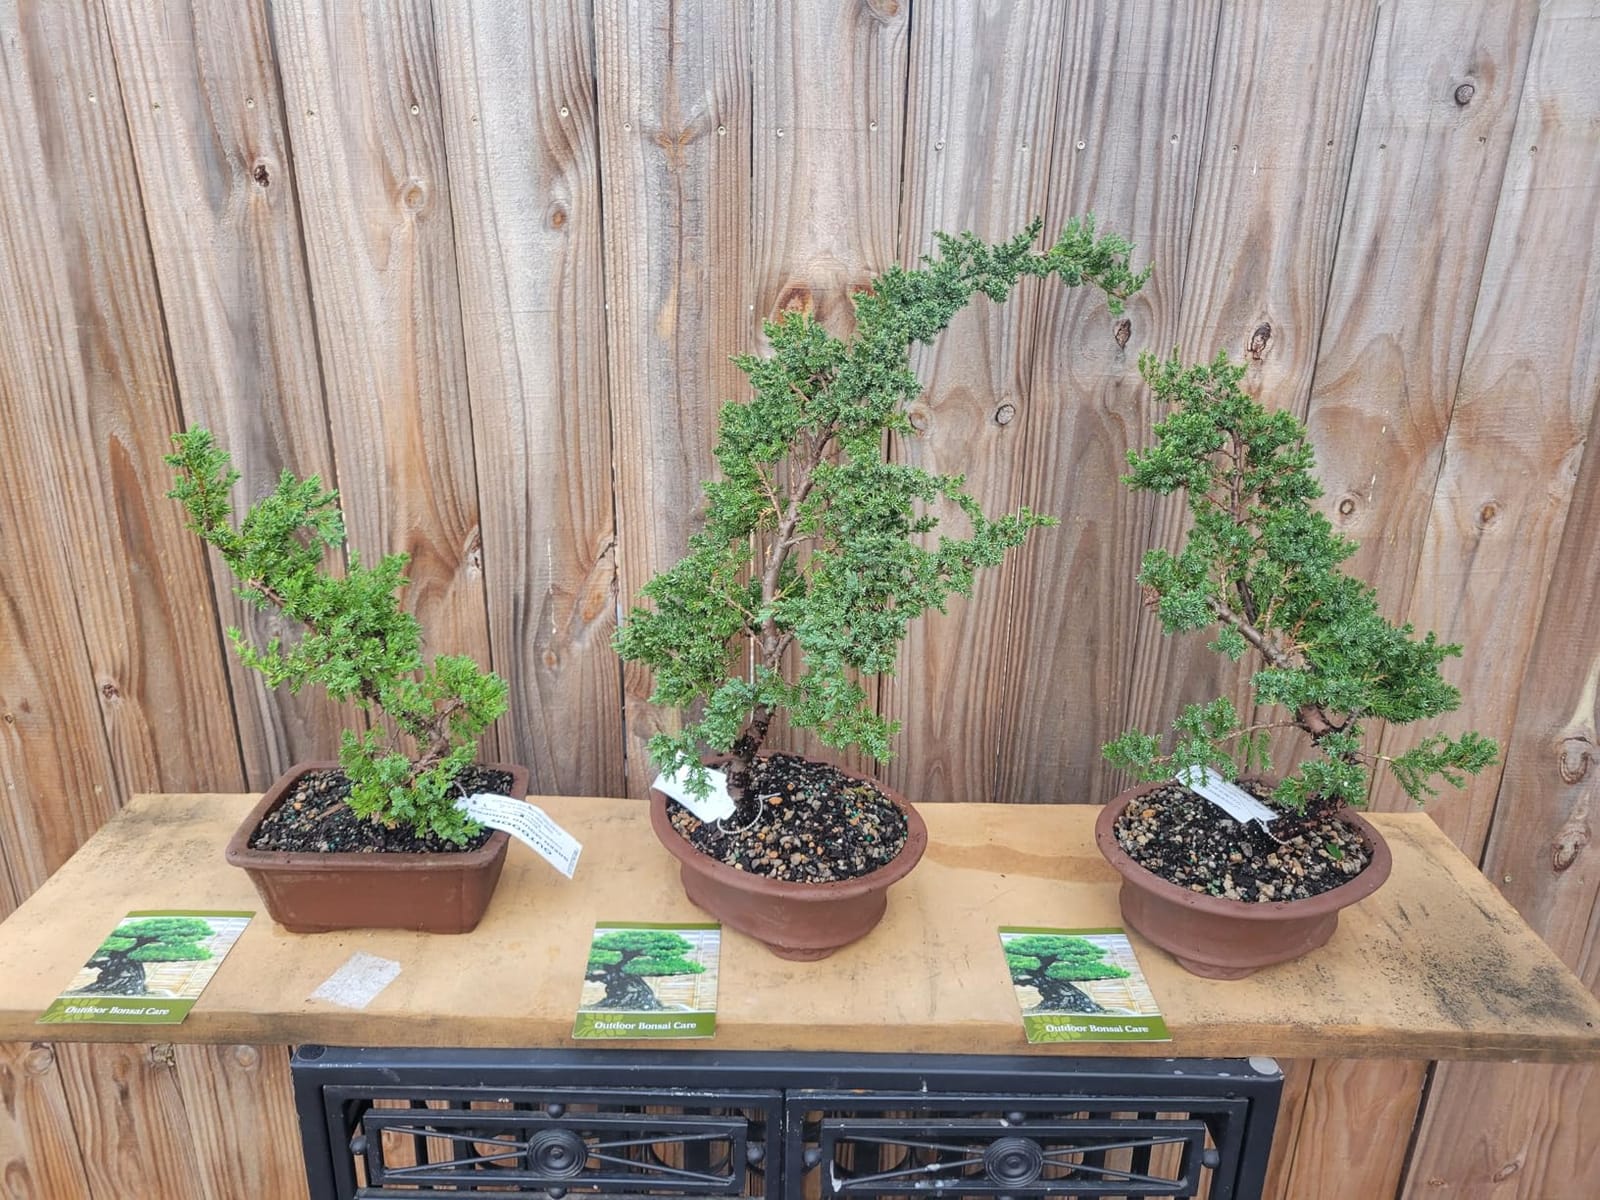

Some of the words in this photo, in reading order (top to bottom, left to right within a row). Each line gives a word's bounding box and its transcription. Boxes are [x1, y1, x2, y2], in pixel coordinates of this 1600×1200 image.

[65, 1006, 109, 1014] Outdoor
[145, 1007, 169, 1015] Care
[594, 1021, 636, 1029] Outdoor
[638, 1022, 671, 1030] Bonsai
[673, 1021, 697, 1029] Care
[1045, 1024, 1087, 1033] Outdoor
[1089, 1024, 1123, 1033] Bonsai
[1124, 1025, 1149, 1033] Care
